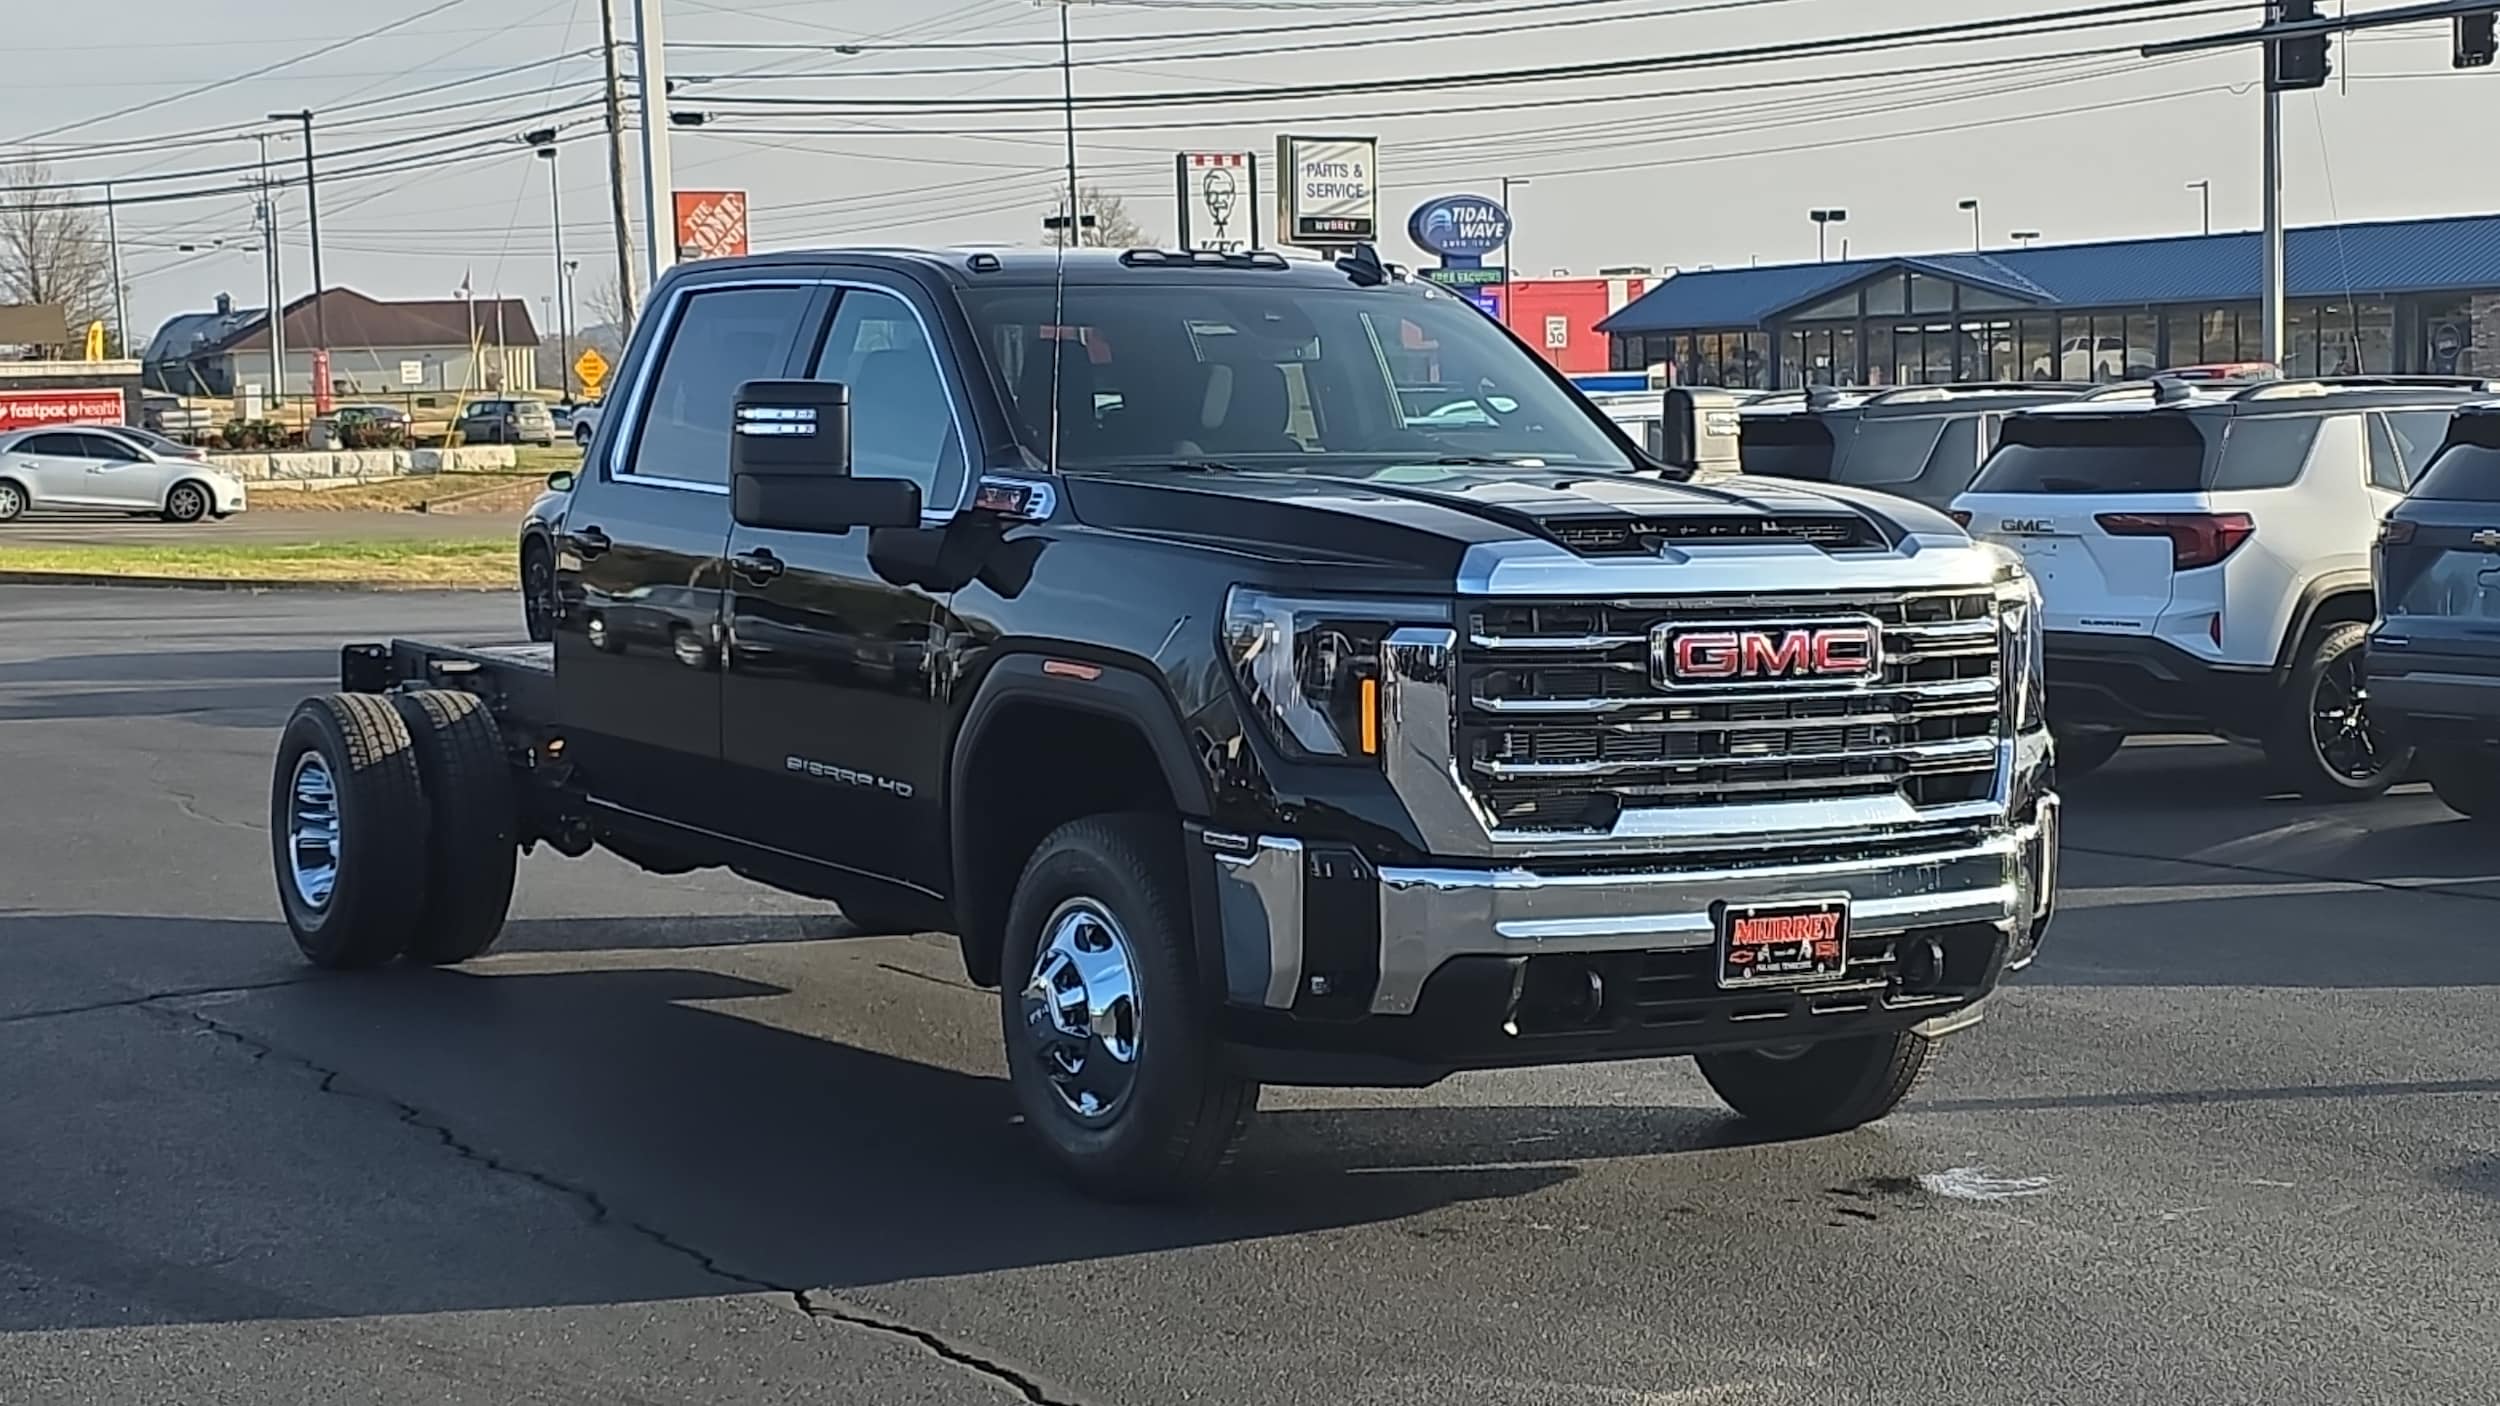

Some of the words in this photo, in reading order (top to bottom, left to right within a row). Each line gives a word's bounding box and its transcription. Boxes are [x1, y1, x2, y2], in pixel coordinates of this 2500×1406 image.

[1306, 163, 1349, 179] PARTS
[1353, 163, 1363, 178] &
[1306, 183, 1365, 199] SERVICE
[684, 200, 714, 231] THE
[1452, 206, 1496, 222] TIDAL
[1459, 222, 1505, 239] WAVE
[1549, 332, 1565, 344] 30
[79, 401, 121, 416] health
[2001, 519, 2055, 533] GMC
[1673, 628, 1871, 678] GMC
[786, 756, 873, 786] SIERRA
[1731, 912, 1841, 946] MURREY
